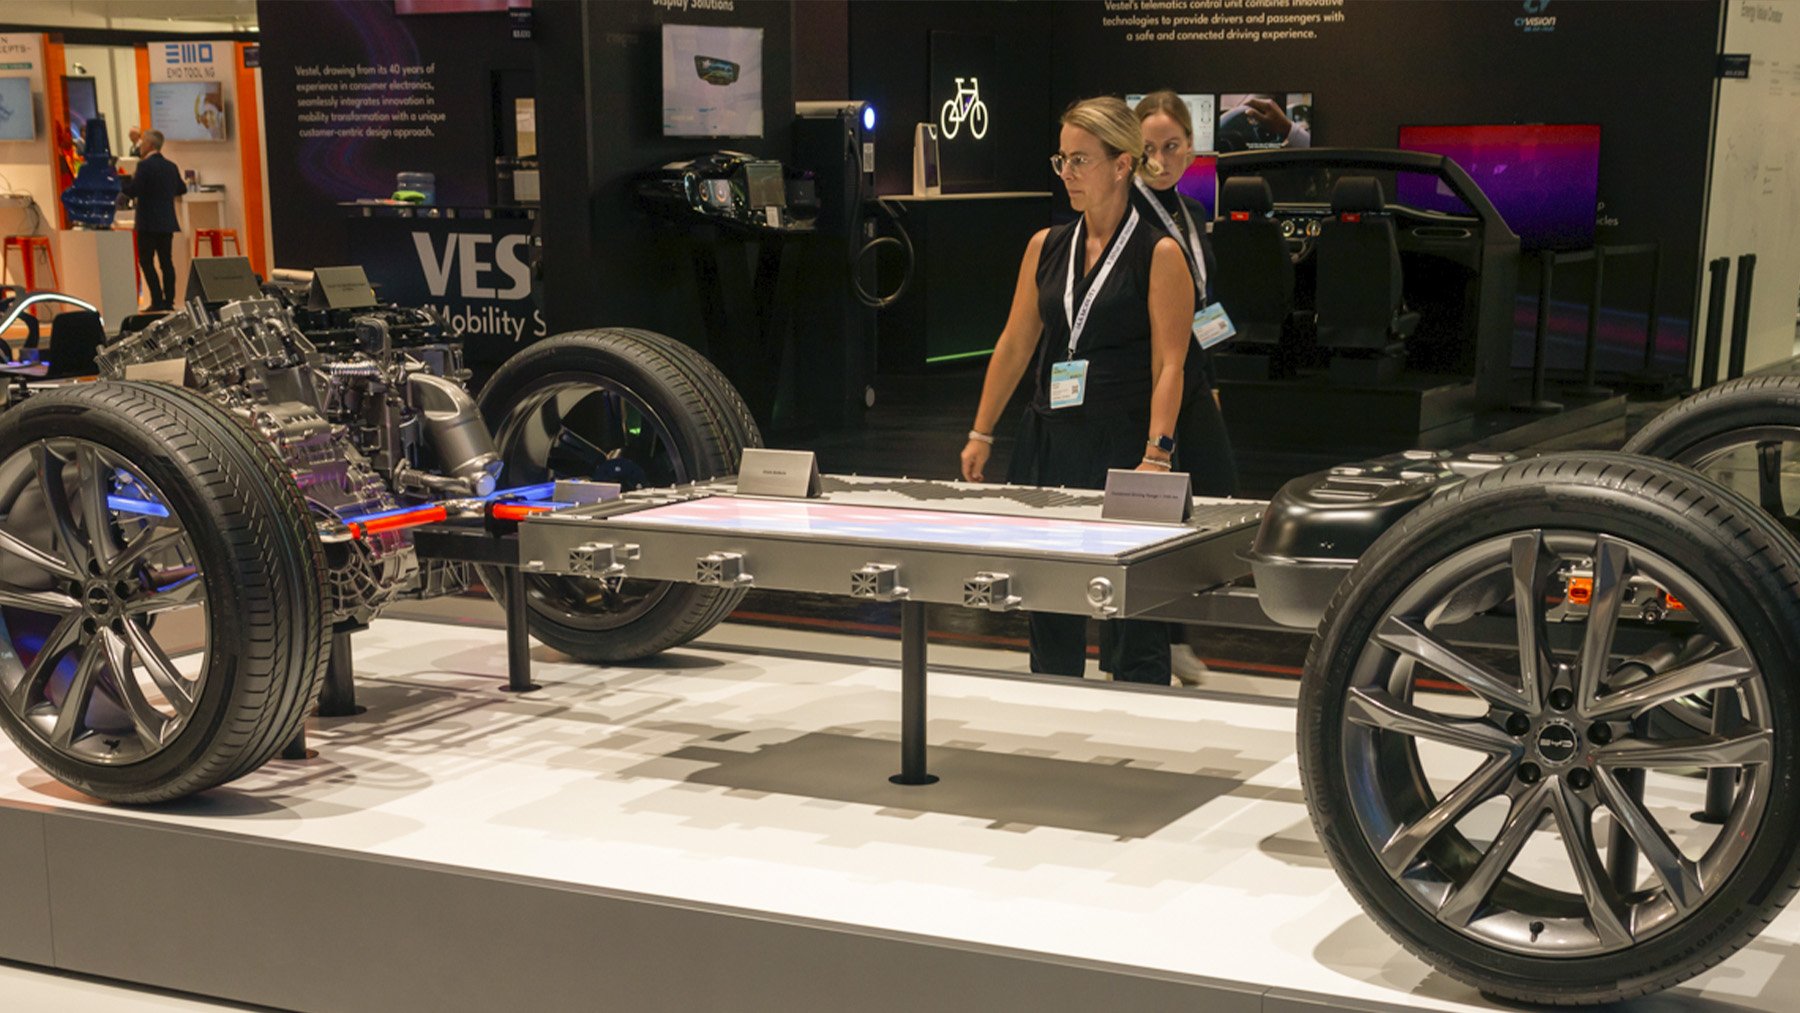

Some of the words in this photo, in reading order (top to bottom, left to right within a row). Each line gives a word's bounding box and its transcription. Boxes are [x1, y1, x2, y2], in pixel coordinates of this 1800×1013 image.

[1105, 0, 1138, 10] Vestel's
[1141, 0, 1186, 10] telematics
[1190, 0, 1222, 9] control
[1225, 0, 1243, 8] unit
[1103, 15, 1159, 28] technologies
[1161, 15, 1171, 25] to
[1174, 14, 1209, 28] provide
[1211, 13, 1243, 24] drivers
[1246, 13, 1265, 23] and
[1266, 13, 1321, 26] passengers
[1323, 11, 1345, 22] with
[1126, 33, 1132, 41] a
[1135, 31, 1154, 41] safe
[1157, 31, 1175, 40] and
[1177, 30, 1224, 40] connected
[1226, 29, 1260, 42] driving
[1262, 30, 1317, 40] experience.
[295, 65, 321, 76] Vestel,
[323, 65, 355, 78] drawing
[357, 64, 376, 75] from
[378, 65, 387, 75] its
[390, 64, 400, 74] 40
[402, 66, 424, 76] years
[426, 63, 435, 74] of
[296, 82, 338, 93] experience
[340, 81, 347, 90] in
[389, 80, 434, 90] electronics,
[298, 96, 338, 108] seamlessly
[340, 96, 380, 109] integrates
[382, 96, 424, 105] innovation
[426, 97, 434, 105] in
[298, 112, 329, 123] mobility
[331, 111, 390, 121] transformation
[392, 111, 409, 121] with
[418, 113, 446, 123] unique
[299, 127, 363, 137] customer-centric
[365, 126, 391, 139] design
[393, 126, 434, 139] approach.
[1596, 214, 1619, 226] icles
[411, 231, 531, 300] VES
[533, 309, 547, 337] S
[1540, 738, 1573, 748] BYD
